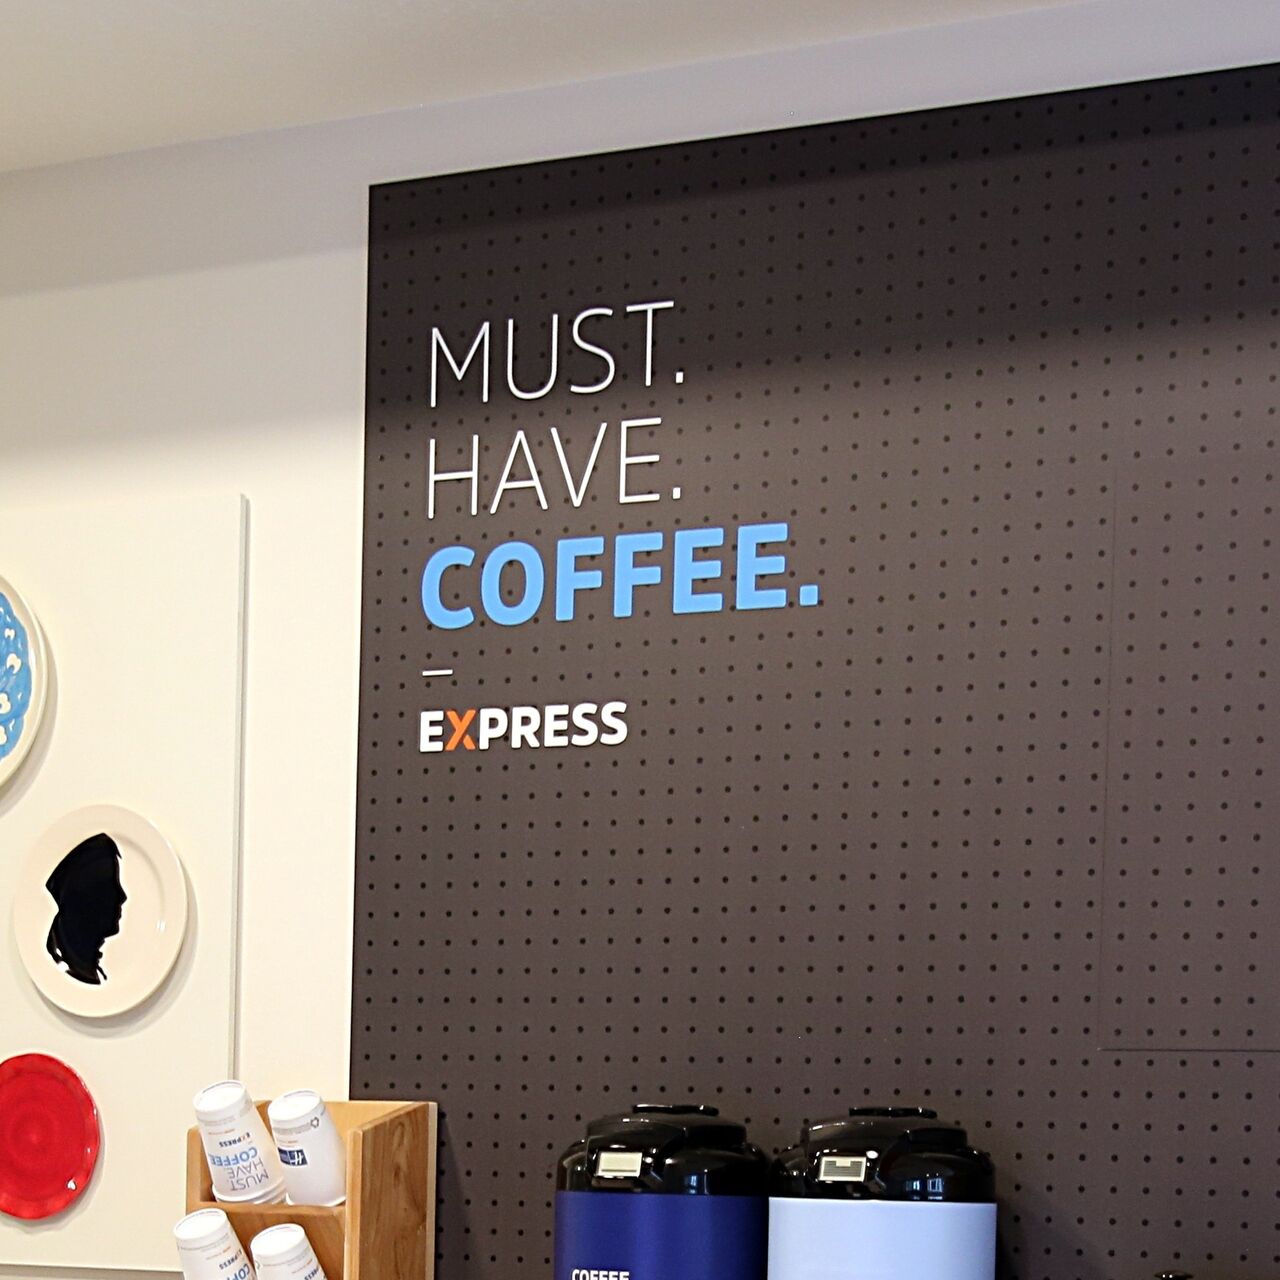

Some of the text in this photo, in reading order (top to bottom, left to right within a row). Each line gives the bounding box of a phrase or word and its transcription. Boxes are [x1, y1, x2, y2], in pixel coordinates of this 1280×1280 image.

[430, 300, 684, 408] MUST.
[427, 417, 681, 519] HAVE.
[422, 522, 819, 630] COFFEE.
[419, 701, 628, 753] EXPRESS
